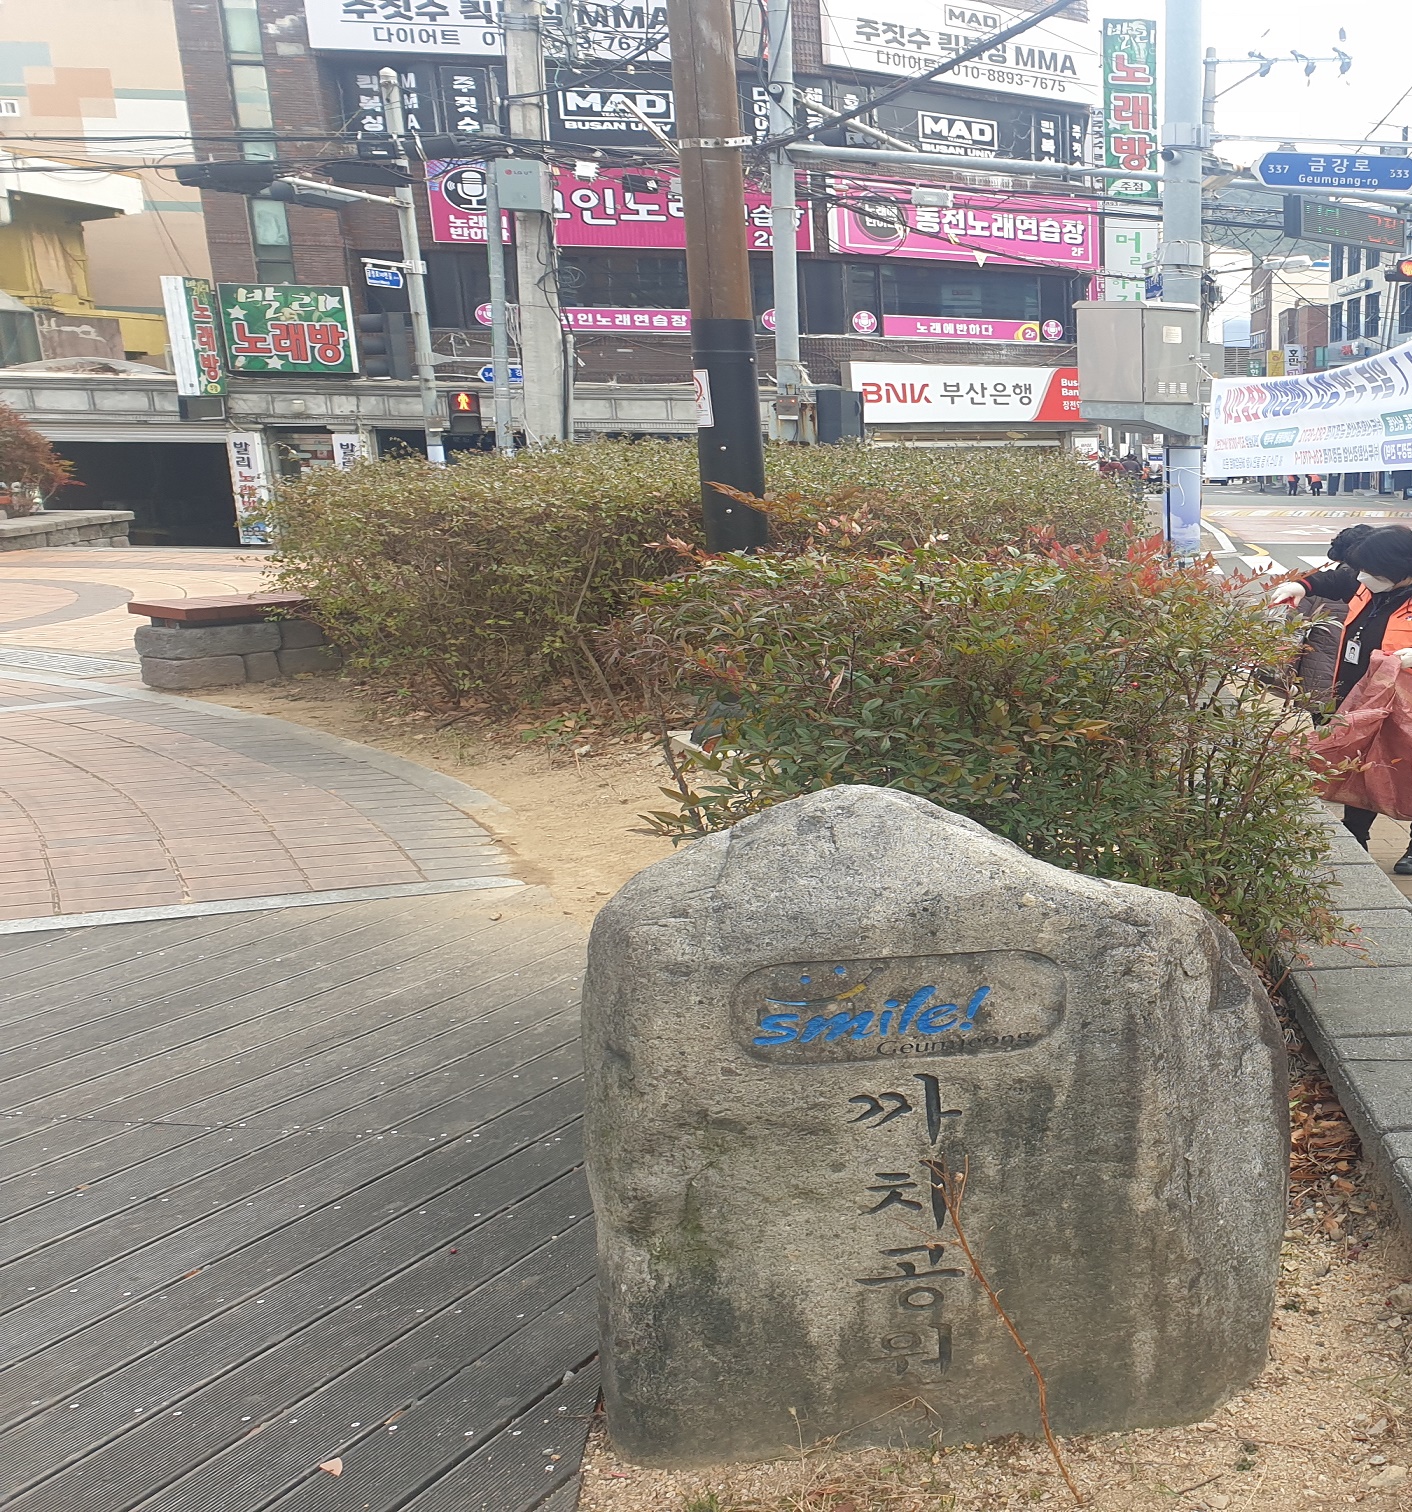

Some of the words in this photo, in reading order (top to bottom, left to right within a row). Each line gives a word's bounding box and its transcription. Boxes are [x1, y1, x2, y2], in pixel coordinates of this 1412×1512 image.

[948, 6, 997, 28] MAD
[373, 26, 461, 45] 다이어트
[856, 17, 931, 50] 주짓수
[1015, 46, 1078, 76] MMA
[951, 63, 1066, 93] 010-8893-7675
[453, 75, 480, 133] 주짓수
[566, 91, 667, 113] MAD
[1109, 52, 1154, 171] 노래방
[564, 120, 631, 131] BUSAN
[923, 115, 993, 142] MAD
[921, 143, 966, 156] BUSAN
[966, 148, 997, 158] UNIV
[1268, 164, 1289, 175] 337
[1307, 157, 1372, 173] 금강로
[1389, 167, 1410, 179] 333
[1120, 181, 1144, 192] 주점
[1298, 173, 1379, 187] Geumgang-ro
[448, 214, 508, 228] 노래
[914, 207, 1085, 245] 동전노래연습장
[449, 227, 511, 241] 반하
[1071, 247, 1085, 257] 2F
[559, 312, 688, 327] 코인노래연습장
[916, 321, 993, 336] 노래에반하다
[191, 296, 220, 382] 노래방
[232, 321, 348, 365] 노래방
[1024, 329, 1037, 339] 2F
[863, 382, 933, 404] BNK
[939, 381, 1033, 406] 부산은행
[1061, 387, 1080, 396] Ban
[233, 441, 253, 469] 발리
[752, 984, 991, 1046] smile!
[876, 1030, 1033, 1058] Geumjeong
